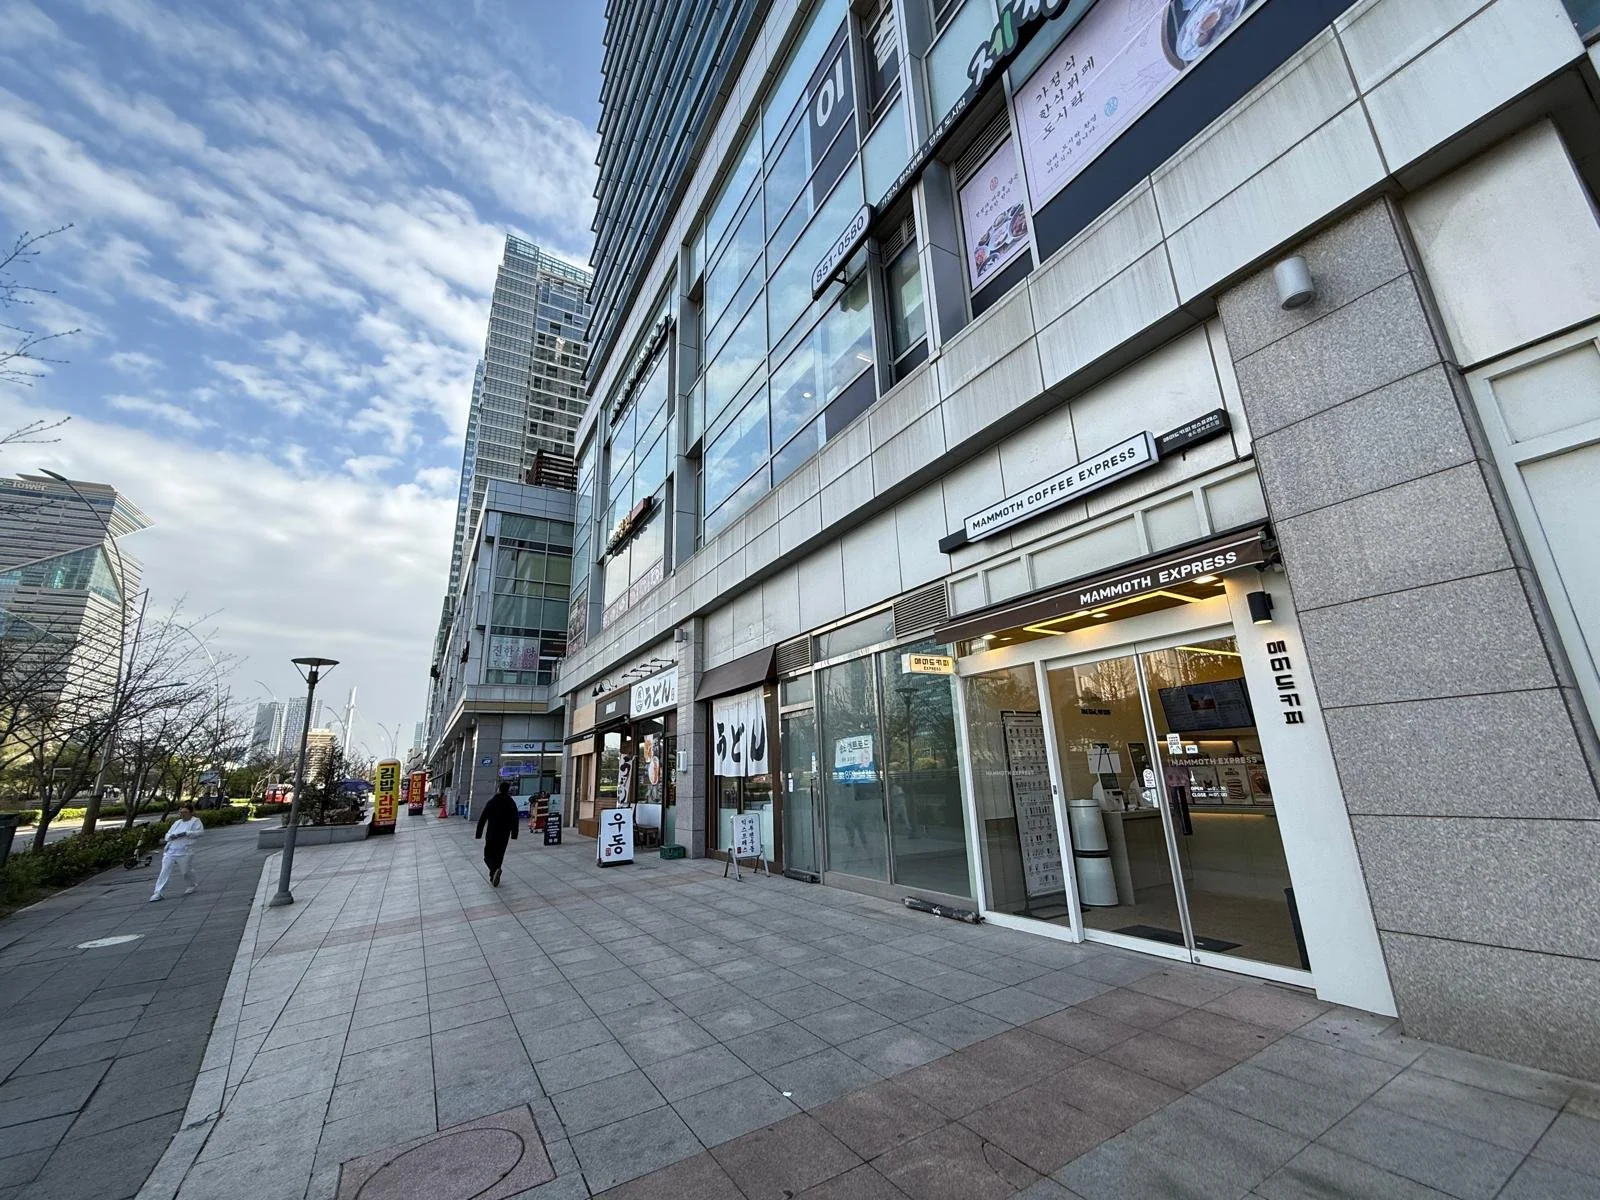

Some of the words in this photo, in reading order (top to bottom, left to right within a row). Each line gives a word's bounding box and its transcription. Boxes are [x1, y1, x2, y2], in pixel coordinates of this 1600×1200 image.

[1036, 55, 1075, 103] 가정식
[1040, 56, 1094, 118] 한식뷔페
[944, 97, 966, 129] 도시락
[1043, 90, 1085, 140] 도시락
[816, 215, 864, 283] 851-0580
[971, 500, 1024, 531] MAMMOTH
[1027, 477, 1074, 505] COFFEE
[1078, 446, 1136, 481] EXPRESS
[1079, 575, 1151, 605] MAMMOTH
[1158, 551, 1237, 583] EXPRESS
[644, 678, 671, 710] うどん
[1266, 639, 1304, 725] 매머드커피
[716, 715, 766, 762] うどん
[1218, 756, 1258, 765] EXPRESS
[607, 813, 626, 855] 우동
